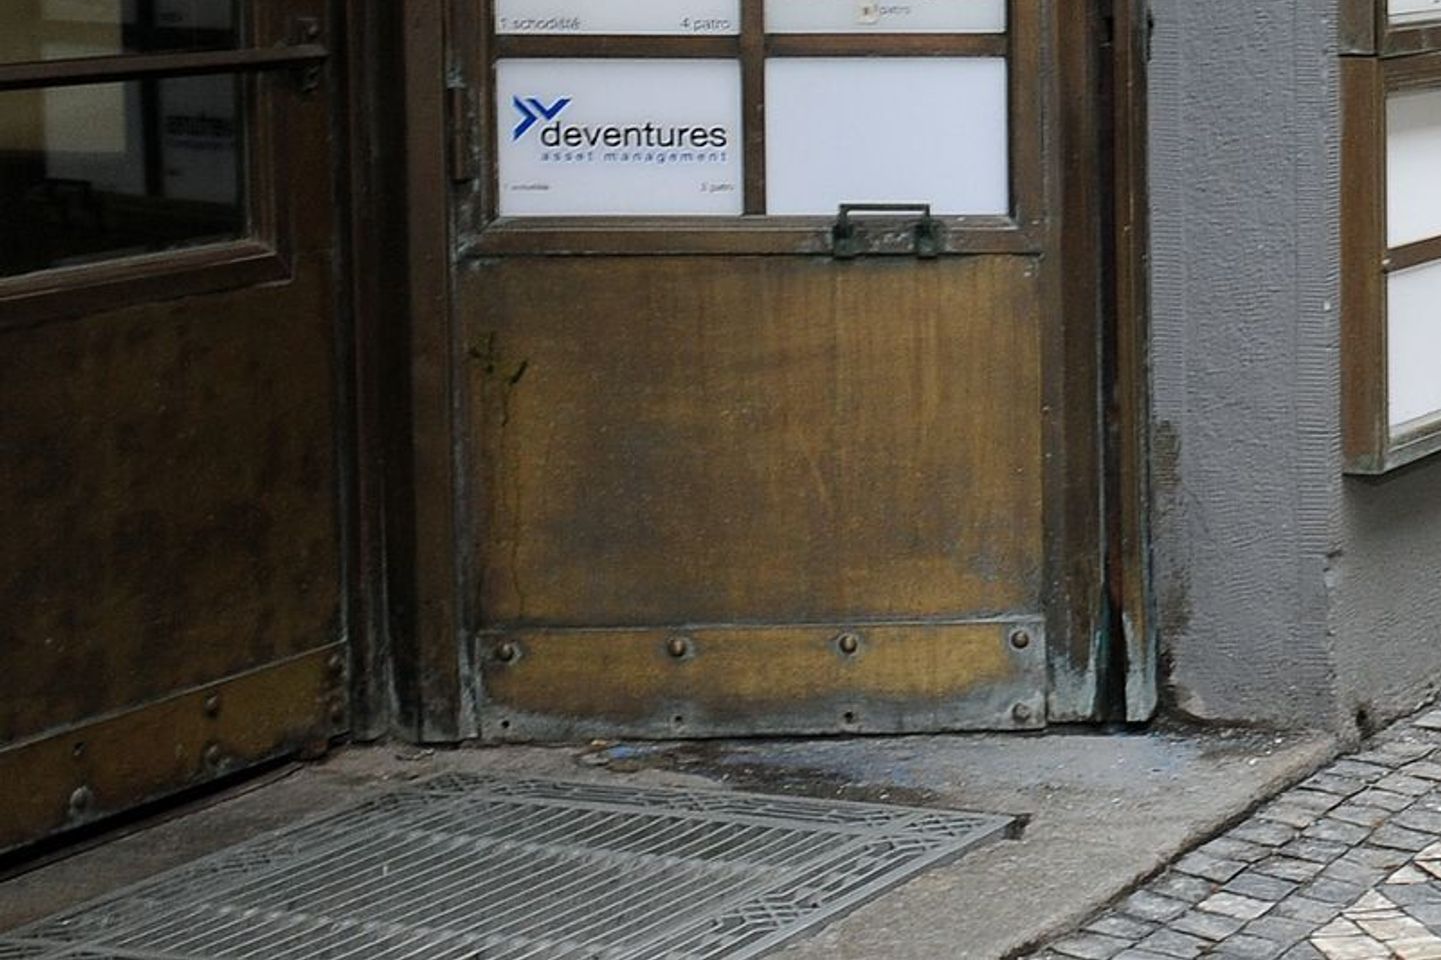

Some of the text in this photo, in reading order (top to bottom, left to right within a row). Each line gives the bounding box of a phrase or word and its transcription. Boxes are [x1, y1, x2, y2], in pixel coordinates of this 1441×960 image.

[540, 120, 728, 148] deventures
[541, 152, 728, 165] asset management
